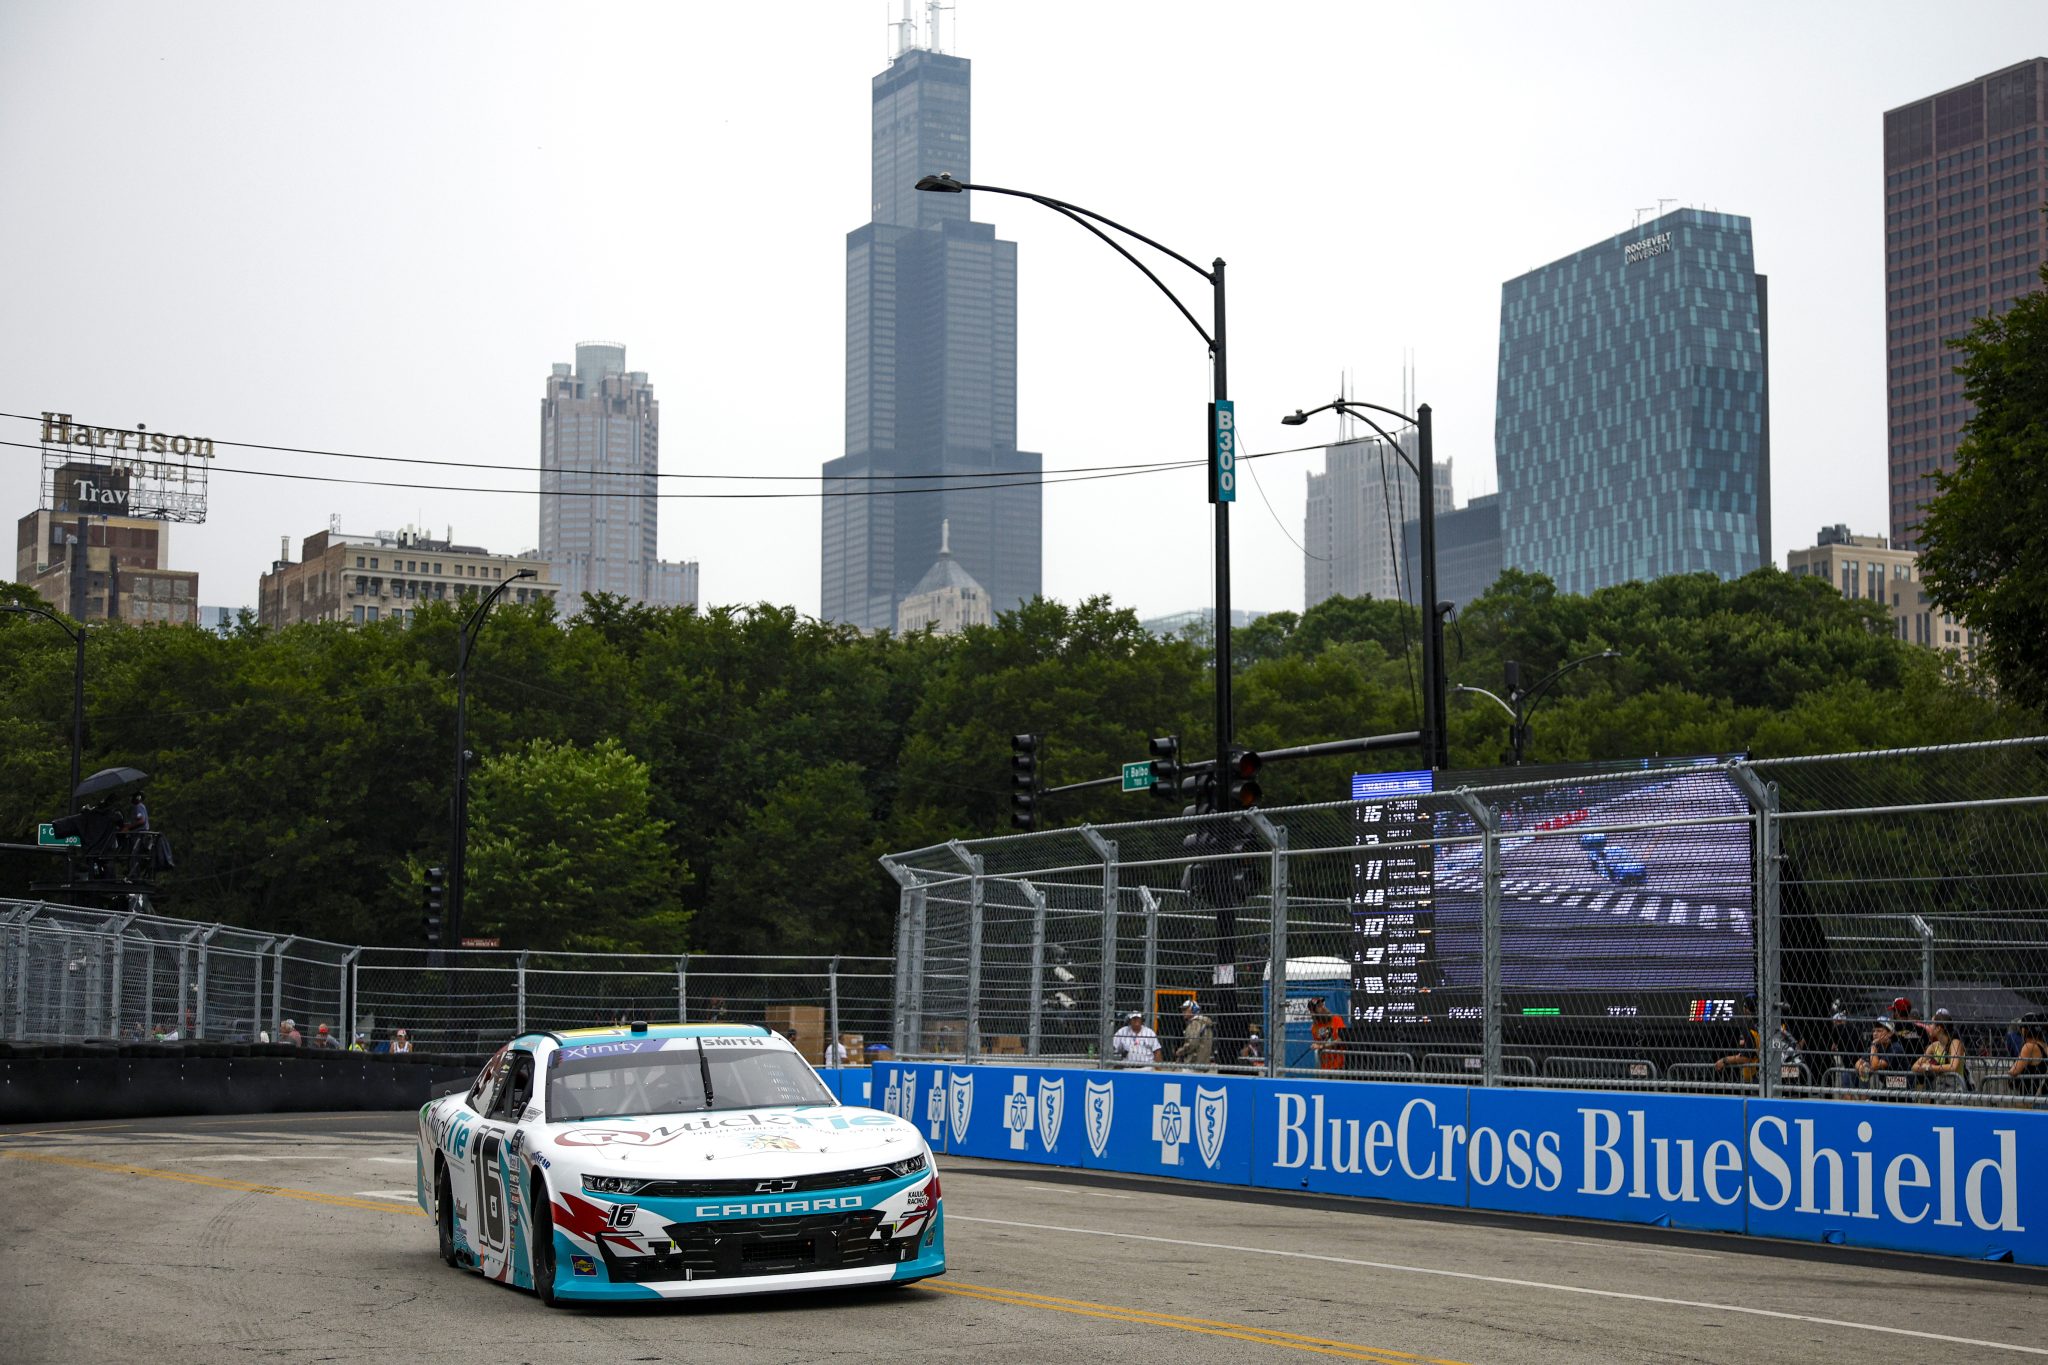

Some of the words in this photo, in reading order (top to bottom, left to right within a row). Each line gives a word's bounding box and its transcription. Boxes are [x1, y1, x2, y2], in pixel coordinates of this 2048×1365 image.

[1625, 232, 1672, 255] ROOSEVELT
[1625, 243, 1671, 265] UNIVERSITY
[41, 412, 215, 458] Harrison
[1218, 410, 1234, 491] B300
[110, 456, 195, 483] HOTEL
[1131, 767, 1149, 778] Balbo
[1364, 805, 1383, 822] 16
[1365, 860, 1383, 880] 11
[1363, 918, 1385, 935] 10
[1363, 947, 1385, 964] 9
[1363, 1006, 1385, 1023] 44
[1711, 1000, 1735, 1021] 75
[568, 1042, 644, 1058] xfinity
[703, 1038, 764, 1046] SMITH
[1273, 1092, 1563, 1192] BlueCross
[1577, 1107, 2026, 1232] BlueShield
[471, 1124, 506, 1253] 16
[607, 1204, 638, 1228] 16
[696, 1195, 863, 1217] CAMARO
